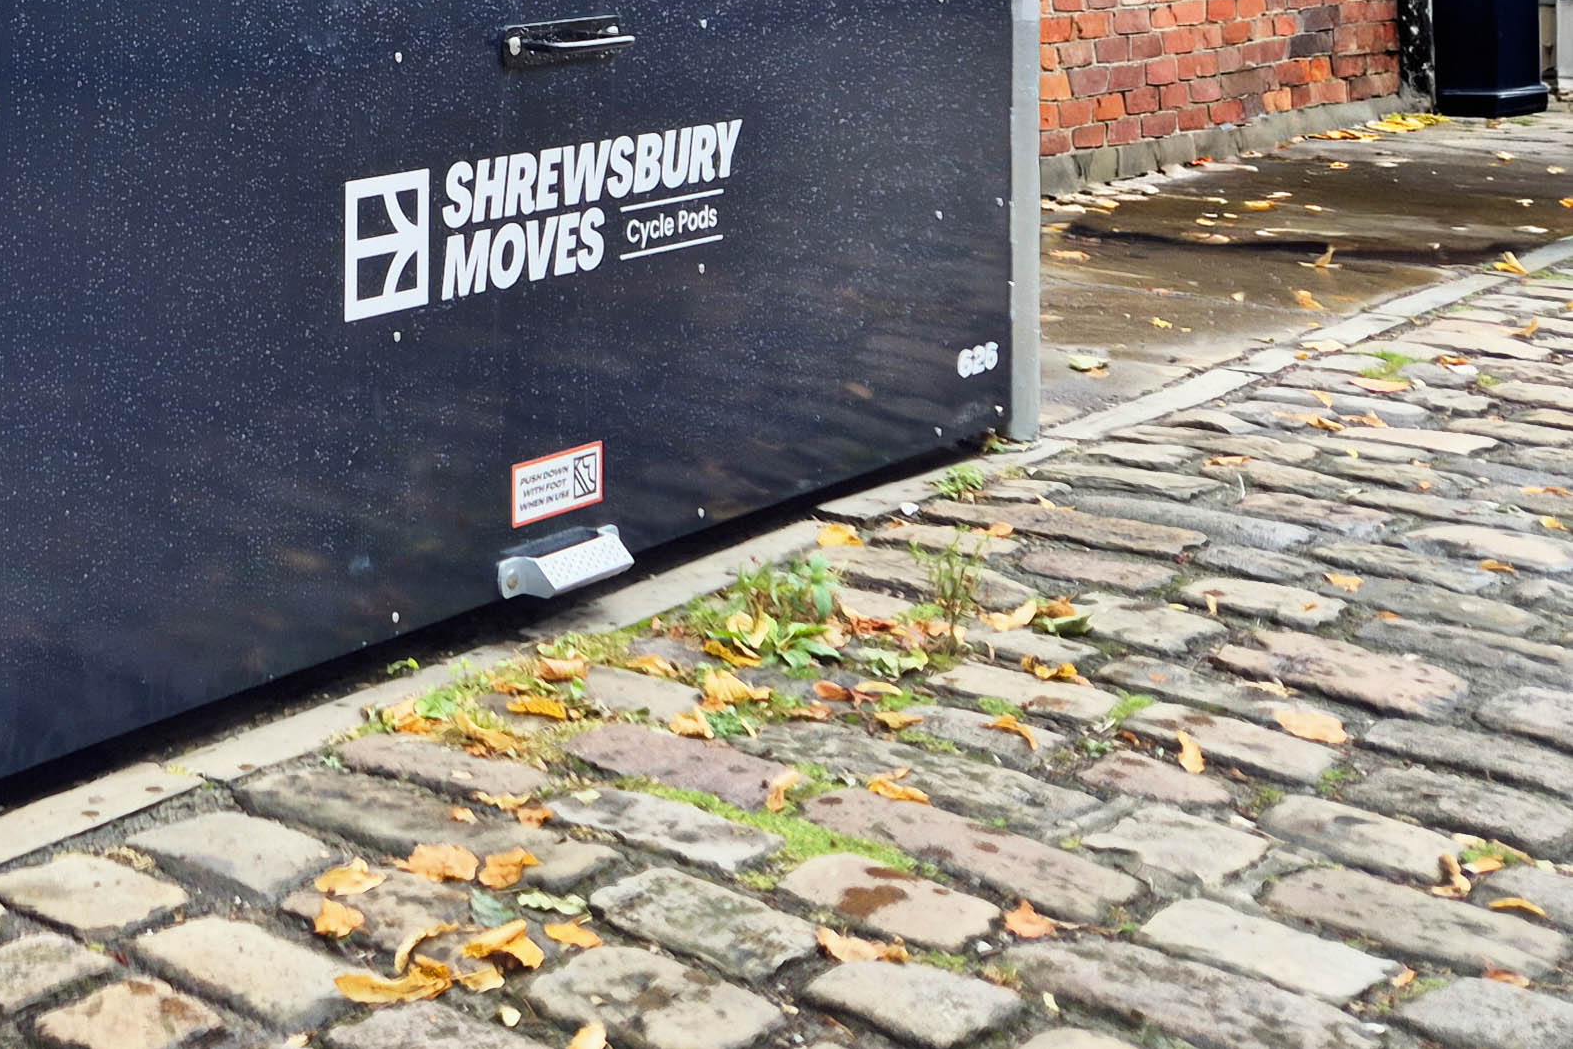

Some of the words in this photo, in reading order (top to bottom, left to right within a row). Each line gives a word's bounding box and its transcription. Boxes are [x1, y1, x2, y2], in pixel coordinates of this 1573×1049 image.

[441, 118, 743, 229] SHREWSBURY
[626, 213, 675, 249] Cycle
[678, 204, 718, 235] Pods
[440, 206, 606, 301] MOVES
[520, 472, 542, 486] PUSH
[543, 465, 569, 480] DOWN
[523, 485, 544, 497] WITH
[545, 478, 567, 492] FOOT
[519, 498, 544, 512] WHEN
[545, 494, 554, 504] IN
[555, 489, 570, 501] USE
